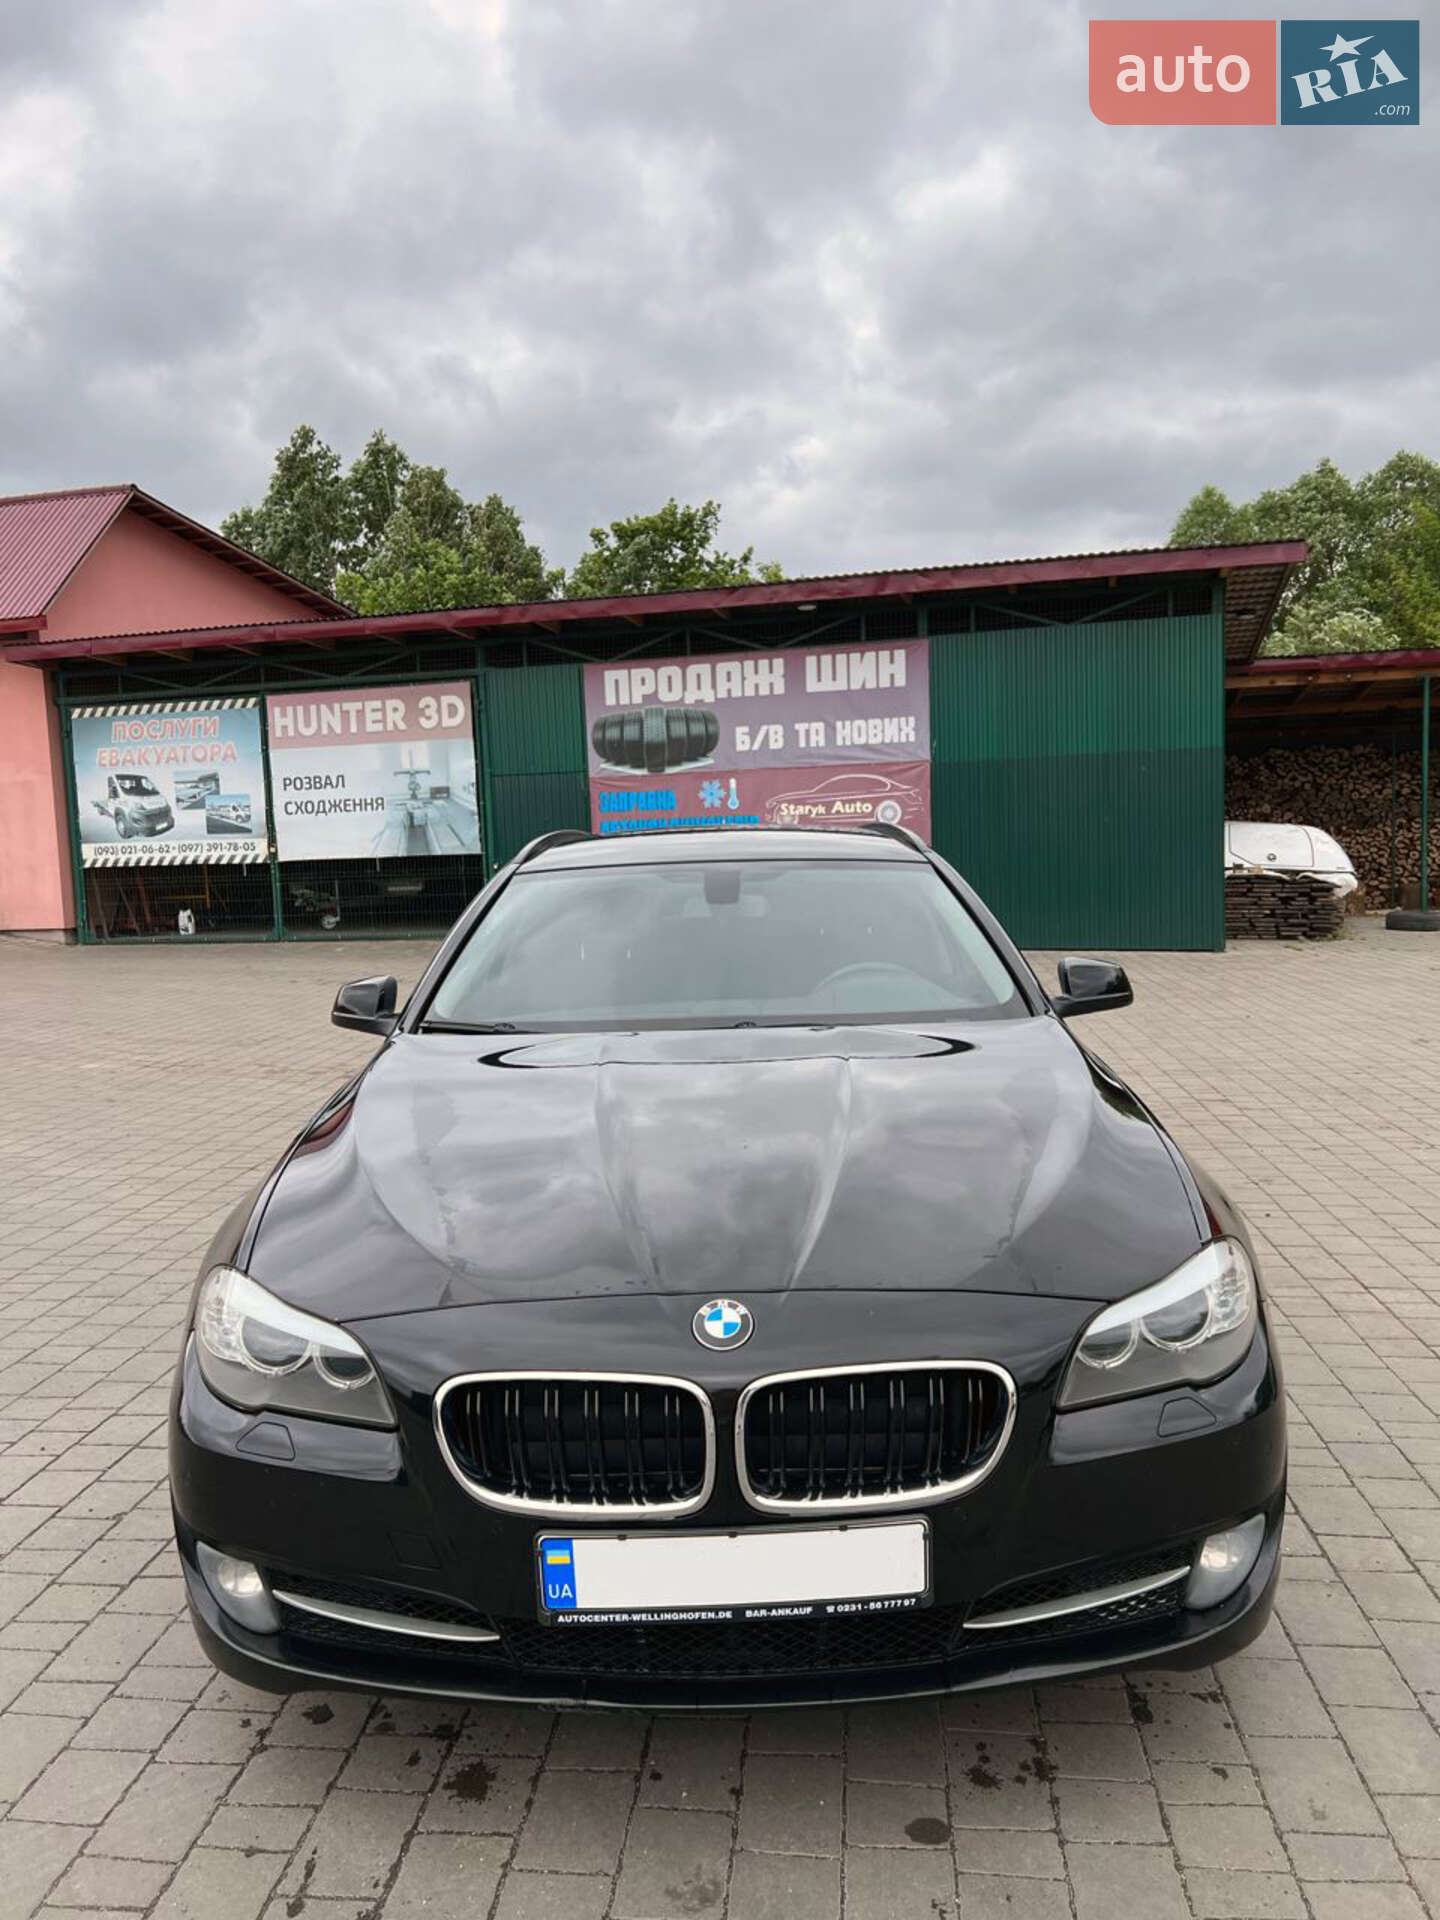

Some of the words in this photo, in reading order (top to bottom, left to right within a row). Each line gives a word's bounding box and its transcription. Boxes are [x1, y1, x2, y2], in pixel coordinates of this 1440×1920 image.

[604, 658, 785, 706] ПРОДАЖ
[805, 649, 906, 692] ШИН
[273, 699, 407, 738] HUNTER
[418, 695, 466, 729] 3D
[112, 716, 220, 743] ПОСЛУГИ
[735, 725, 784, 752] Б/В
[795, 722, 826, 748] ТА
[836, 716, 916, 745] НОВИХ
[97, 743, 238, 768] ЕВАКУАТОРА
[283, 774, 346, 791] РОЗВАЛ
[284, 796, 385, 816] СХОДЖЕННЯ
[779, 803, 826, 818] Staryk
[831, 800, 873, 814] Auto
[94, 845, 119, 857] (093)
[177, 842, 203, 854] (097)
[548, 1583, 573, 1599] UA
[557, 1610, 733, 1623] AUTOCENTER-WELLINGHOFEN.DE
[745, 1606, 813, 1618] BAR-ANKAUF
